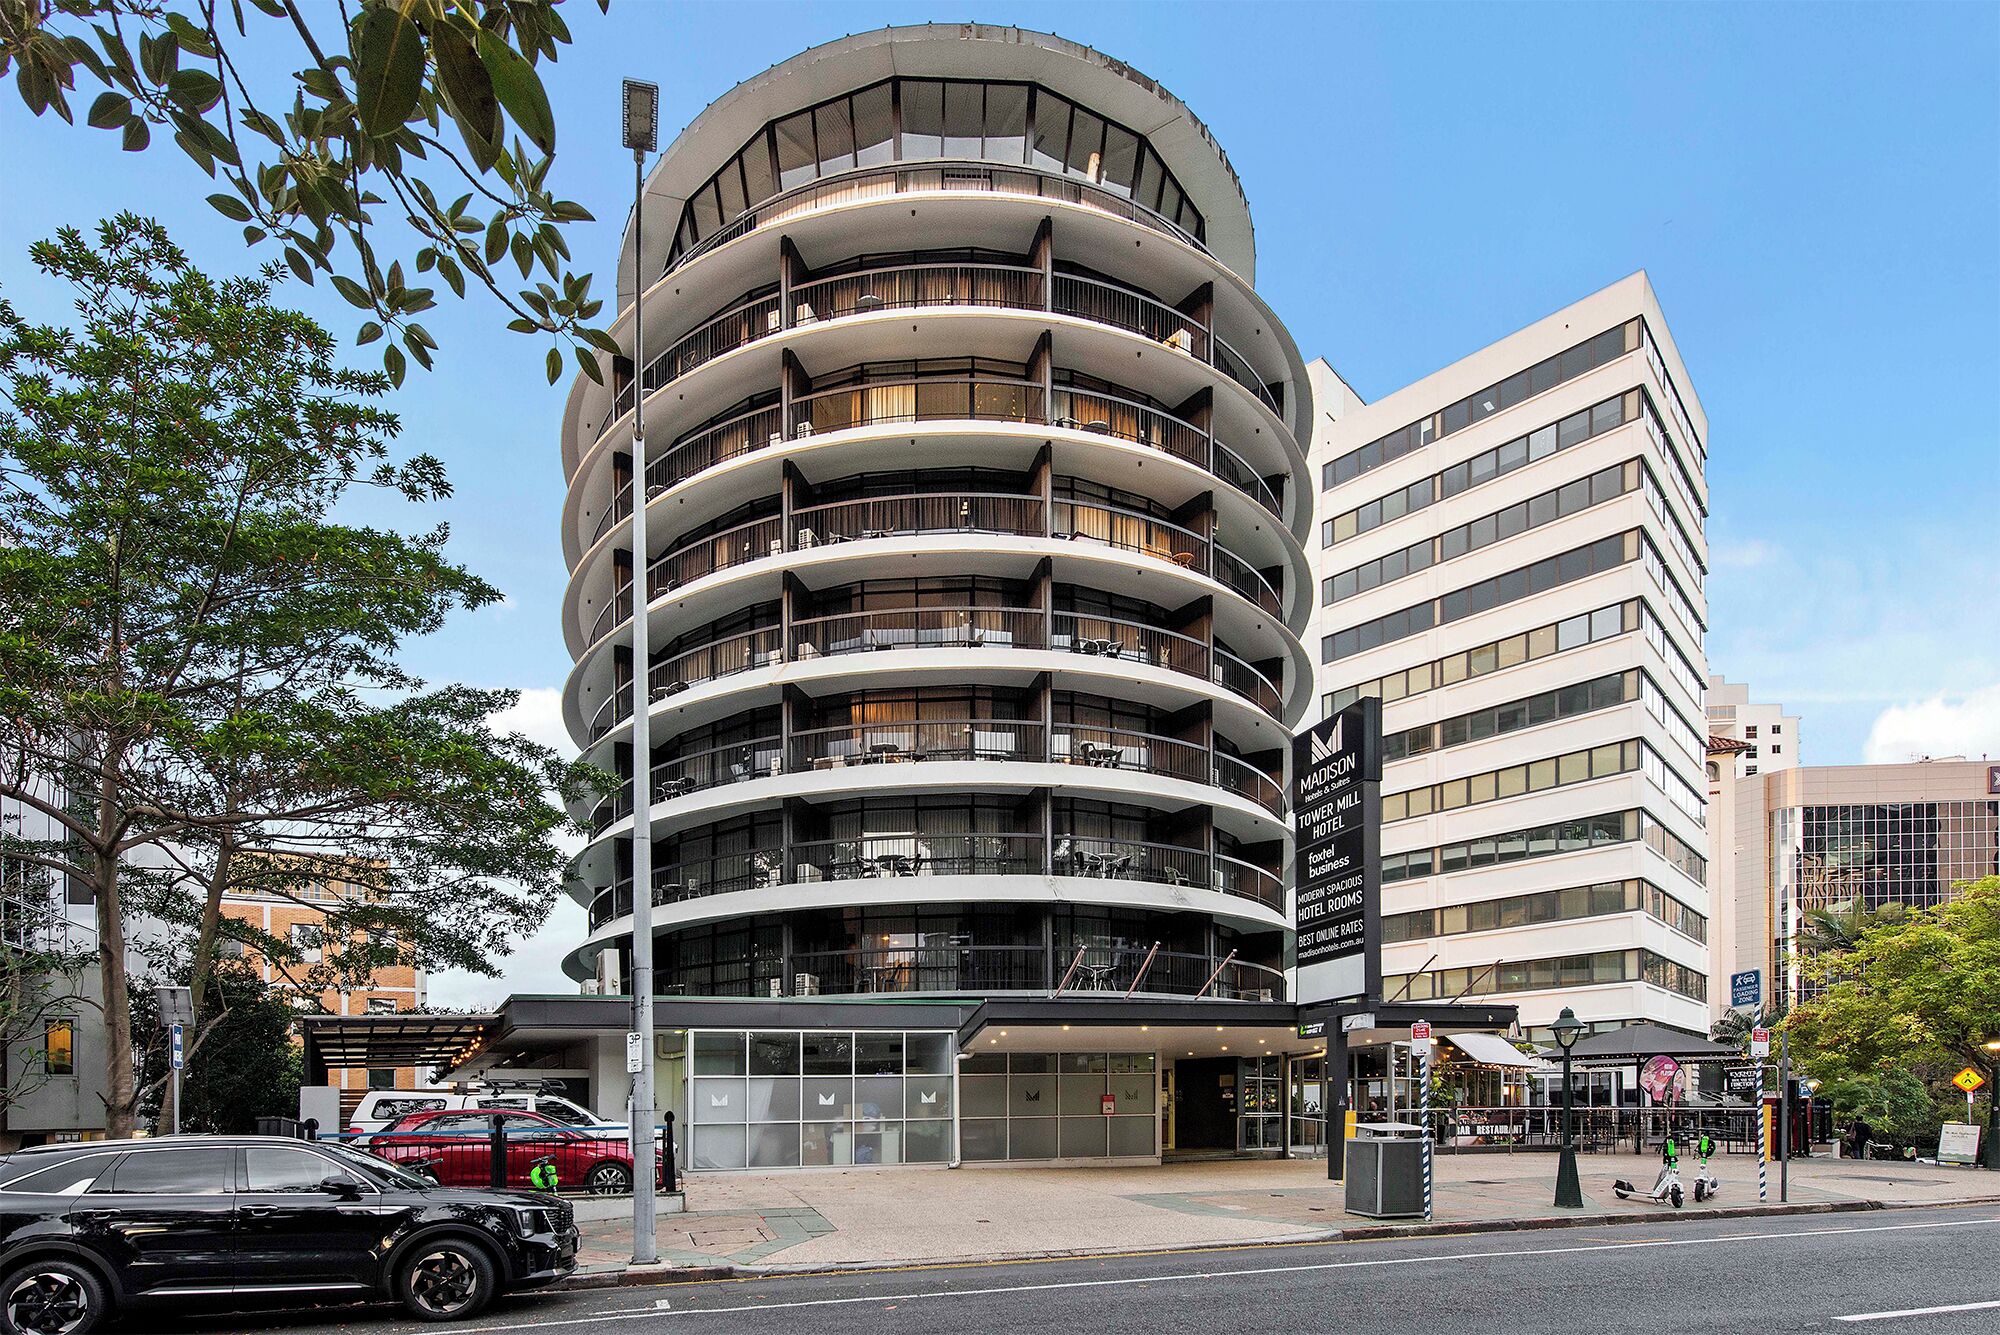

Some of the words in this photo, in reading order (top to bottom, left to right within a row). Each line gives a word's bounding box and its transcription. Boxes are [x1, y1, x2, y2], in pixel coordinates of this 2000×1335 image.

[1300, 752, 1355, 794] MADISON
[1305, 789, 1323, 803] Hotels
[1323, 785, 1331, 794] &
[1330, 776, 1350, 791] Suites
[1299, 802, 1333, 829] TOWER
[1337, 790, 1361, 813] MILL
[1313, 815, 1345, 839] HOTEL
[1308, 844, 1335, 865] foxtel
[1309, 855, 1350, 878] business
[1298, 887, 1325, 905] MODERN
[1326, 874, 1363, 895] SPACIOUS
[1298, 902, 1326, 922] HOTEL
[1328, 890, 1363, 913] ROOMS
[1298, 933, 1314, 948] BEST
[1316, 925, 1339, 943] ONLINE
[1340, 918, 1364, 936] RATES
[1298, 937, 1364, 959] madisonhotels.com.au
[1733, 988, 1759, 999] LOADING
[1738, 995, 1754, 1003] ZONE
[629, 1034, 641, 1044] 3P
[1476, 1125, 1523, 1135] RESTAURANT
